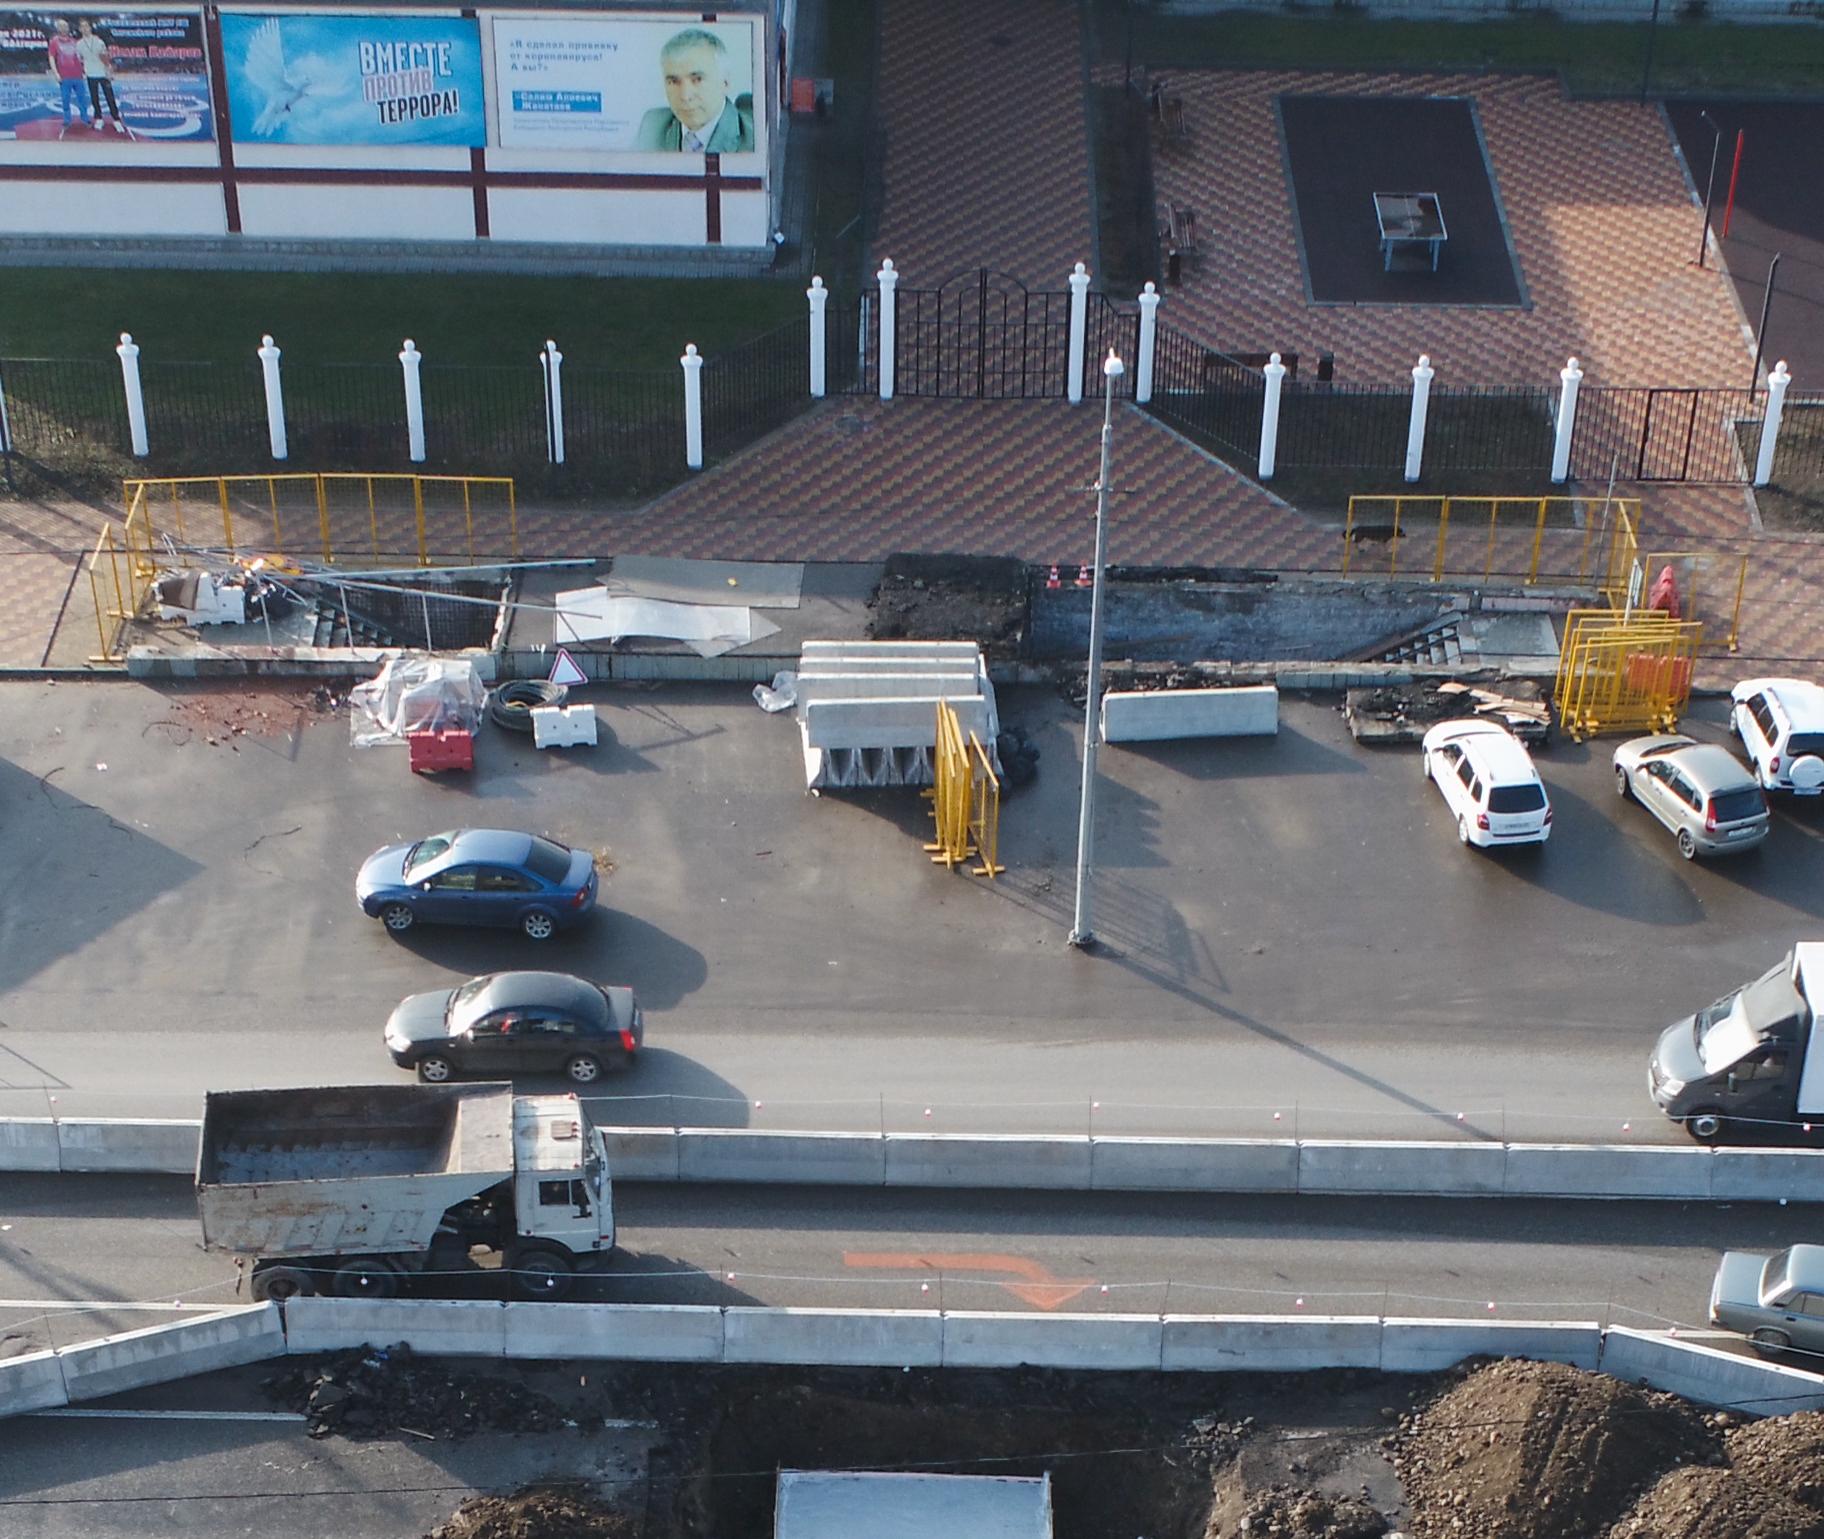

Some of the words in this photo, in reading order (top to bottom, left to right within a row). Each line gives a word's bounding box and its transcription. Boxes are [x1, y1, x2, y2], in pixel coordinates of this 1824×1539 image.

[359, 41, 453, 78] ВМЕСТЕ
[364, 69, 434, 102] ПРОТИВ
[377, 88, 459, 124] ТЕРРОРА!
